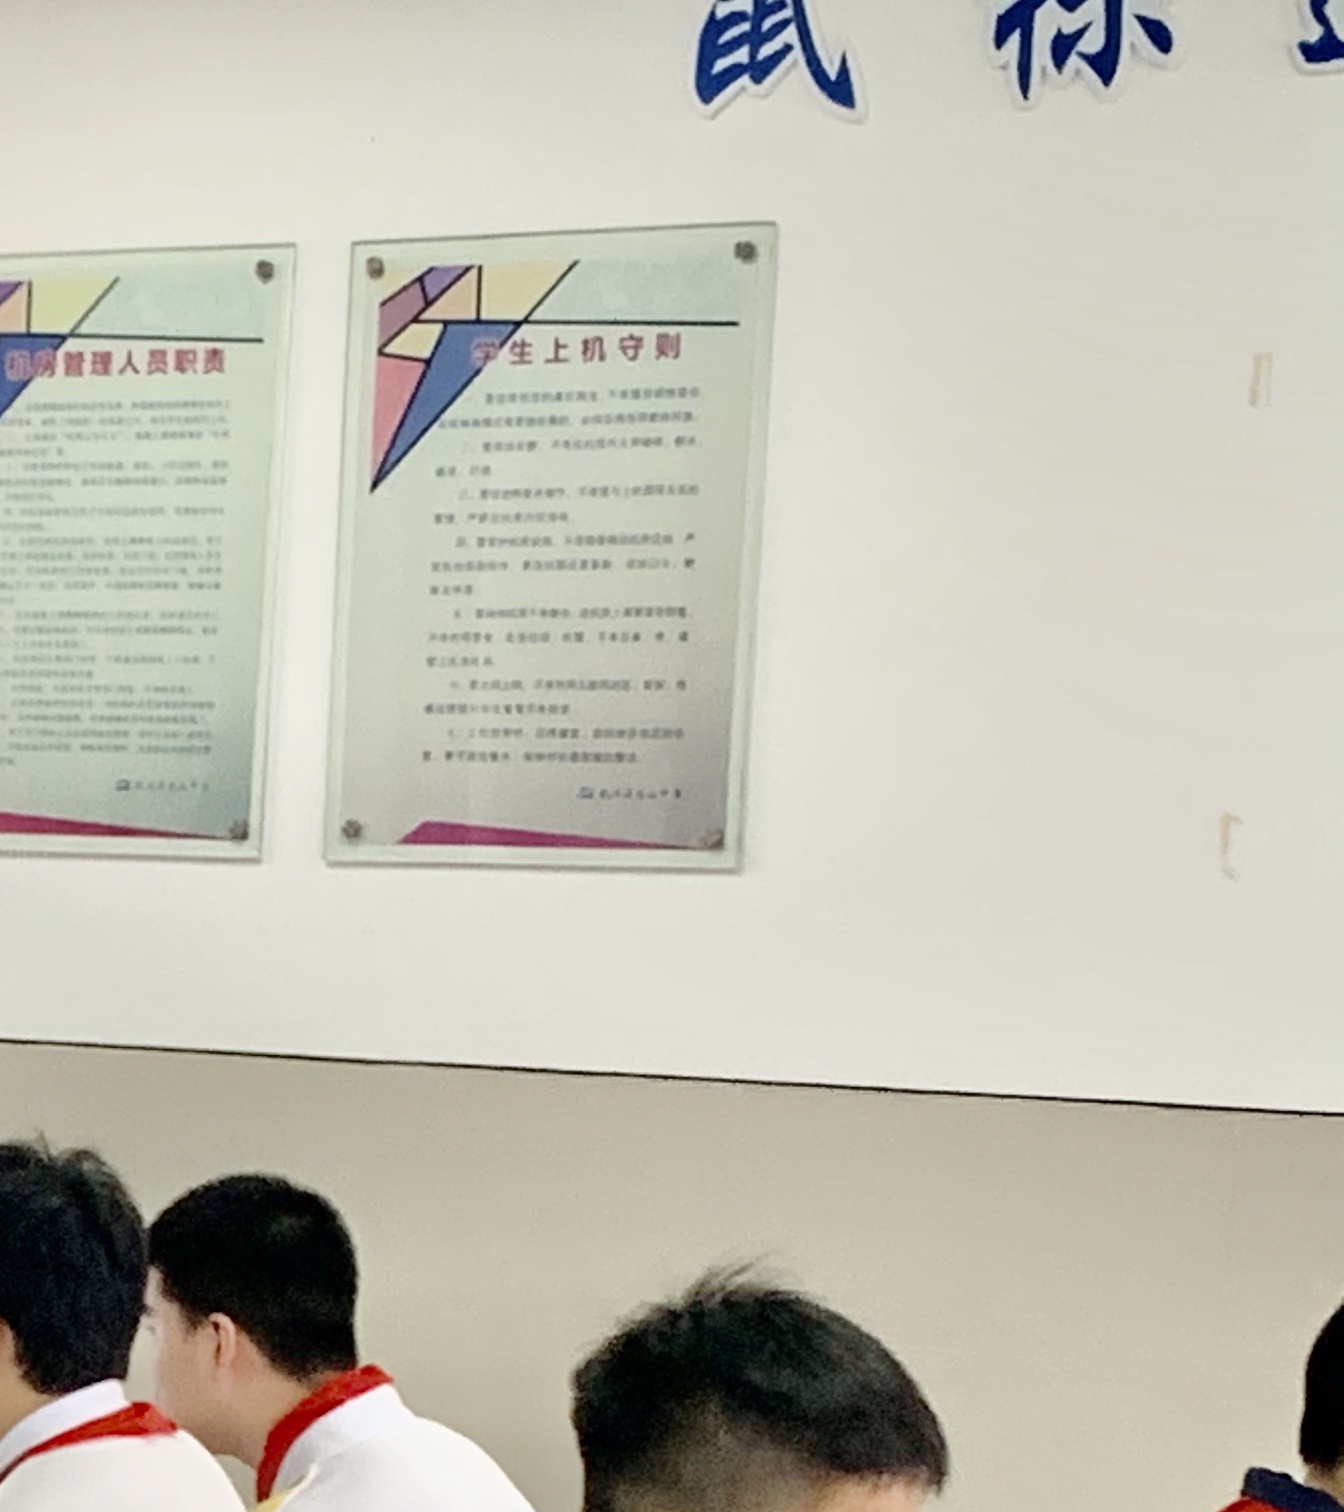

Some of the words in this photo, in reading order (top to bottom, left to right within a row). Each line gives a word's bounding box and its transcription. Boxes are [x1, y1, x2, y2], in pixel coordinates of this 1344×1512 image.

[4, 347, 226, 380] 机房管理人员职责
[469, 332, 682, 365] 学生上机守则
